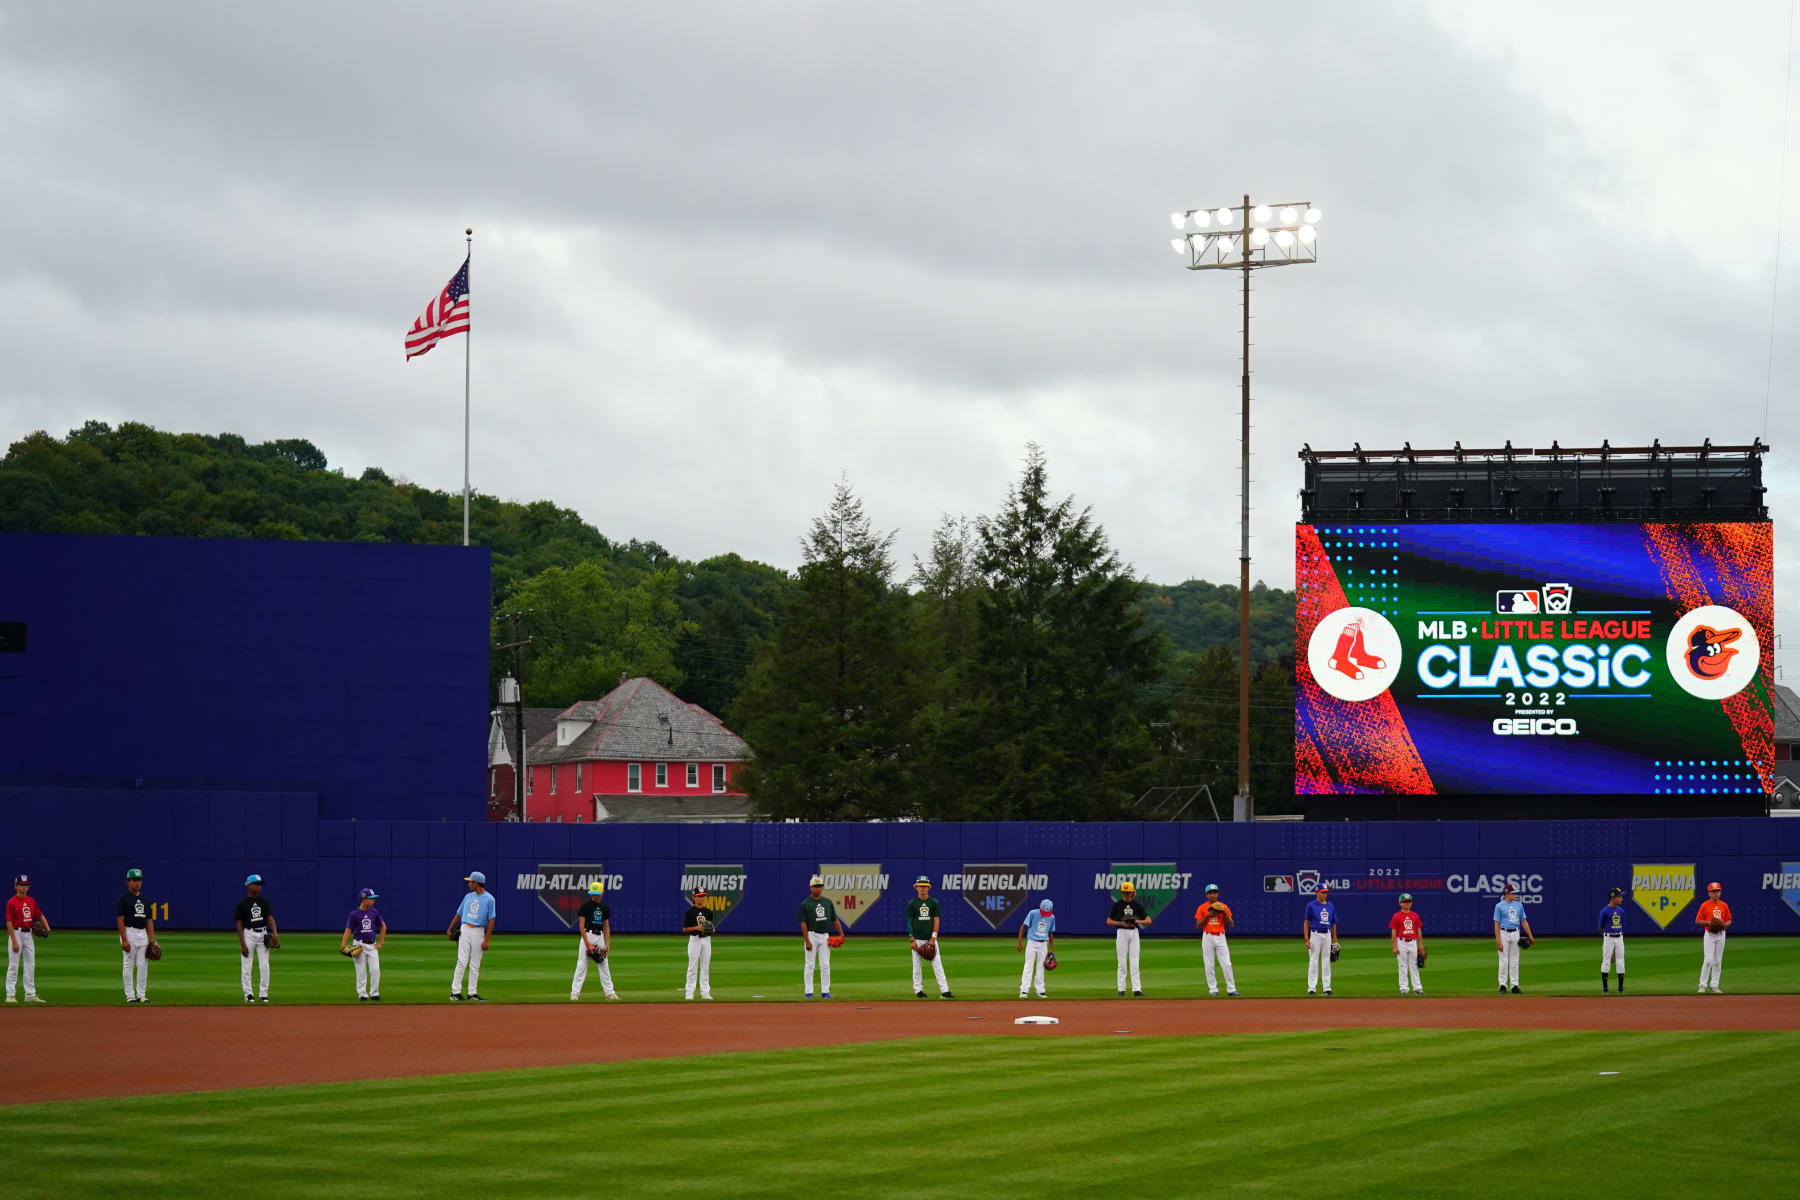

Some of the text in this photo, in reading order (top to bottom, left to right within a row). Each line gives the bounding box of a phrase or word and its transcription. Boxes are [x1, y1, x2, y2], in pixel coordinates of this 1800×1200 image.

[1418, 620, 1467, 639] MLB
[1561, 620, 1651, 639] LEAGUE
[1505, 692, 1566, 705] 2022
[1493, 718, 1577, 735] GEICO
[1369, 868, 1401, 876] 2022
[680, 874, 748, 891] MIDWEST
[941, 874, 1049, 890] NEW ENGLAND
[1324, 879, 1350, 889] MLB
[1398, 878, 1445, 889] LEAGUE
[1631, 874, 1696, 891] PANAMA
[844, 896, 856, 909] M
[985, 896, 1005, 911] NE
[1660, 896, 1669, 911] P
